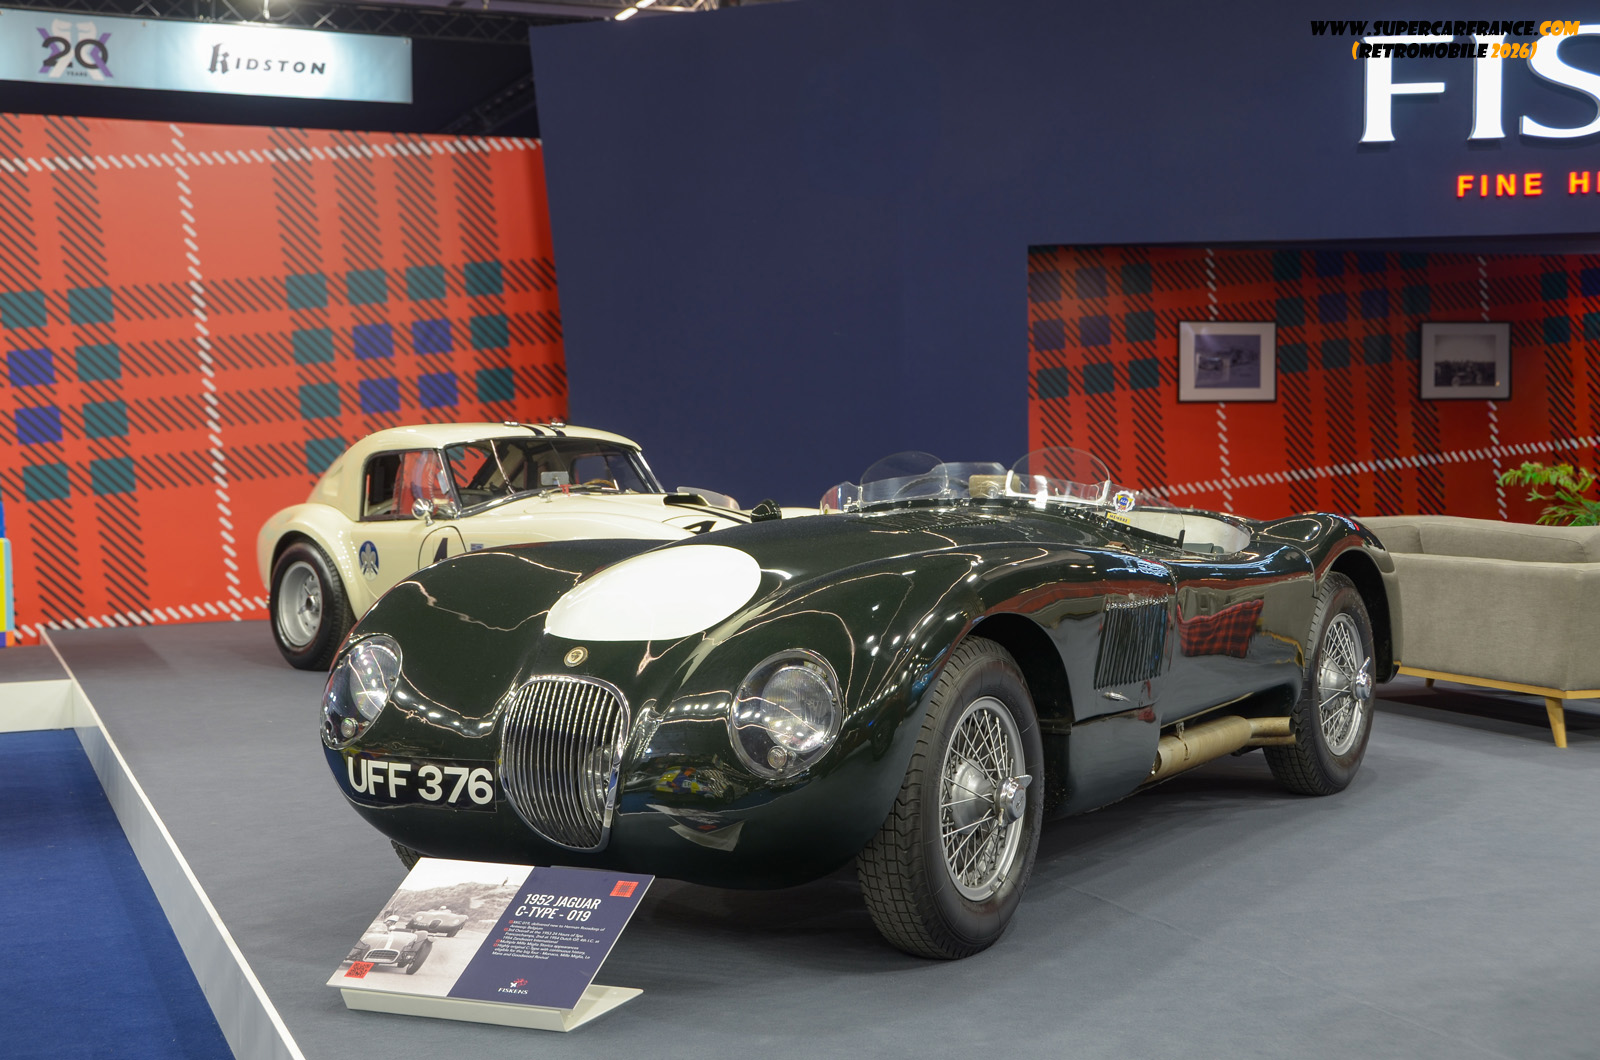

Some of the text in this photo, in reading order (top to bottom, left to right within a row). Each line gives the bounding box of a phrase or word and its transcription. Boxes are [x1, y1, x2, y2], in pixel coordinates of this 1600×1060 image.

[42, 36, 108, 69] 20
[1457, 172, 1543, 198] FINE
[347, 756, 494, 805] UFF 376
[524, 893, 602, 910] 1952 JAGUAR
[514, 905, 560, 919] C-TYPE
[566, 909, 592, 922] 019
[498, 987, 529, 995] FISKENS
